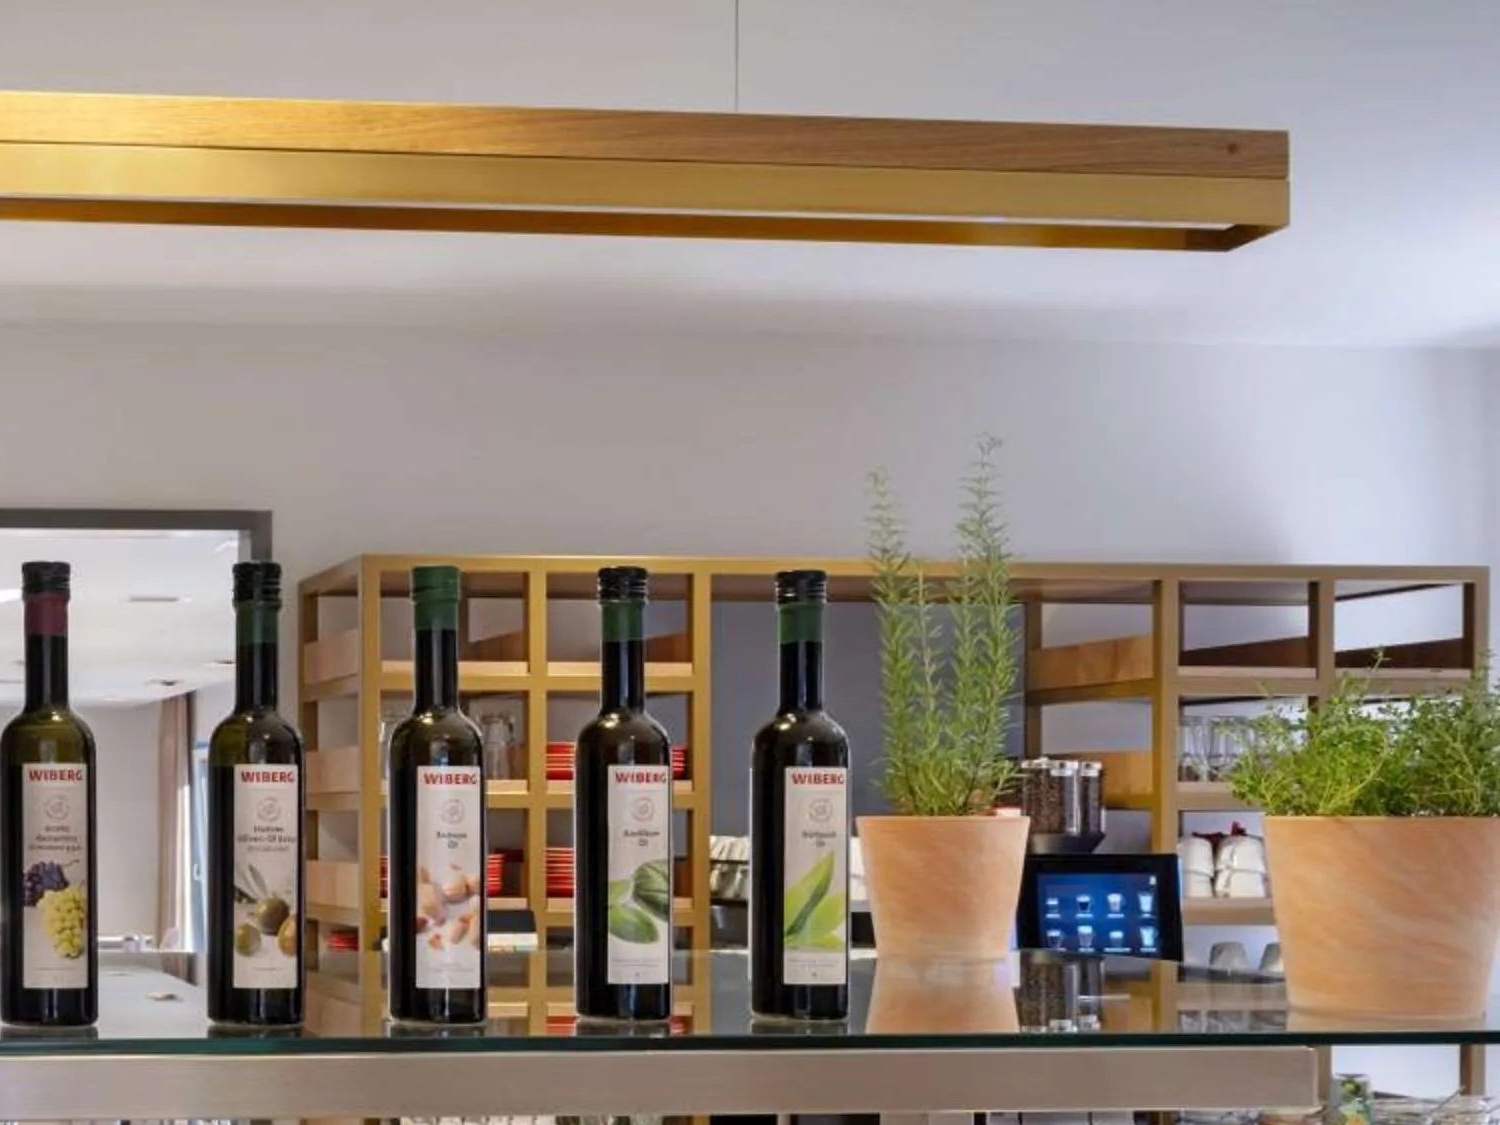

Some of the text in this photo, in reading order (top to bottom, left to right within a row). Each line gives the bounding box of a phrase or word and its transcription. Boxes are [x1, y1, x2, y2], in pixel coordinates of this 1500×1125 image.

[28, 769, 83, 781] WIBERG
[241, 771, 295, 783] WIBERG
[423, 773, 477, 785] WIBERG
[615, 772, 667, 784] WIBERG
[791, 773, 845, 785] WIBERG
